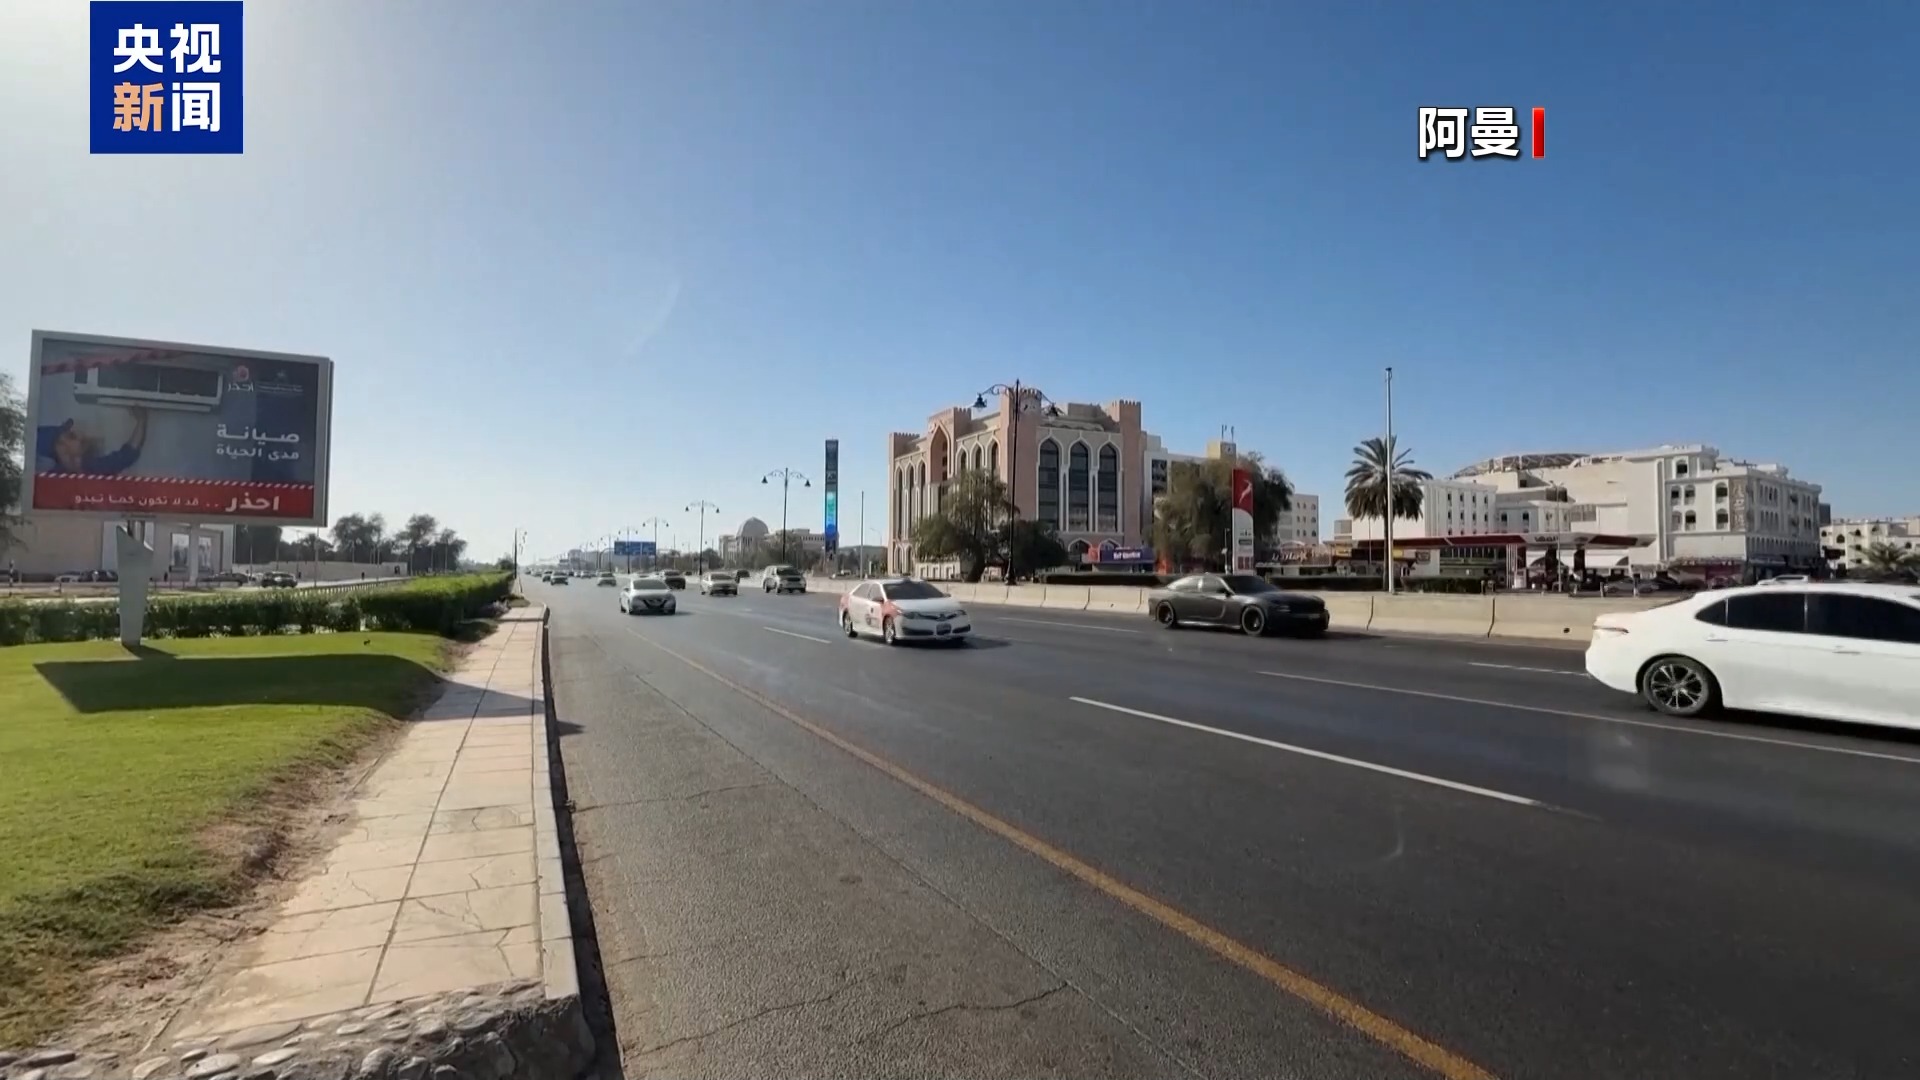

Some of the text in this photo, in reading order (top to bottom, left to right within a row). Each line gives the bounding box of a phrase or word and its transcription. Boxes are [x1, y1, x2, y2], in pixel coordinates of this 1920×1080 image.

[216, 423, 300, 445] صيانة
[216, 443, 300, 461] مدى الحياة
[75, 493, 104, 505] تبدو
[108, 493, 134, 504] كما
[138, 495, 168, 507] تكون
[172, 496, 181, 506] لا
[184, 496, 199, 506] قد
[225, 491, 280, 512] احذر
